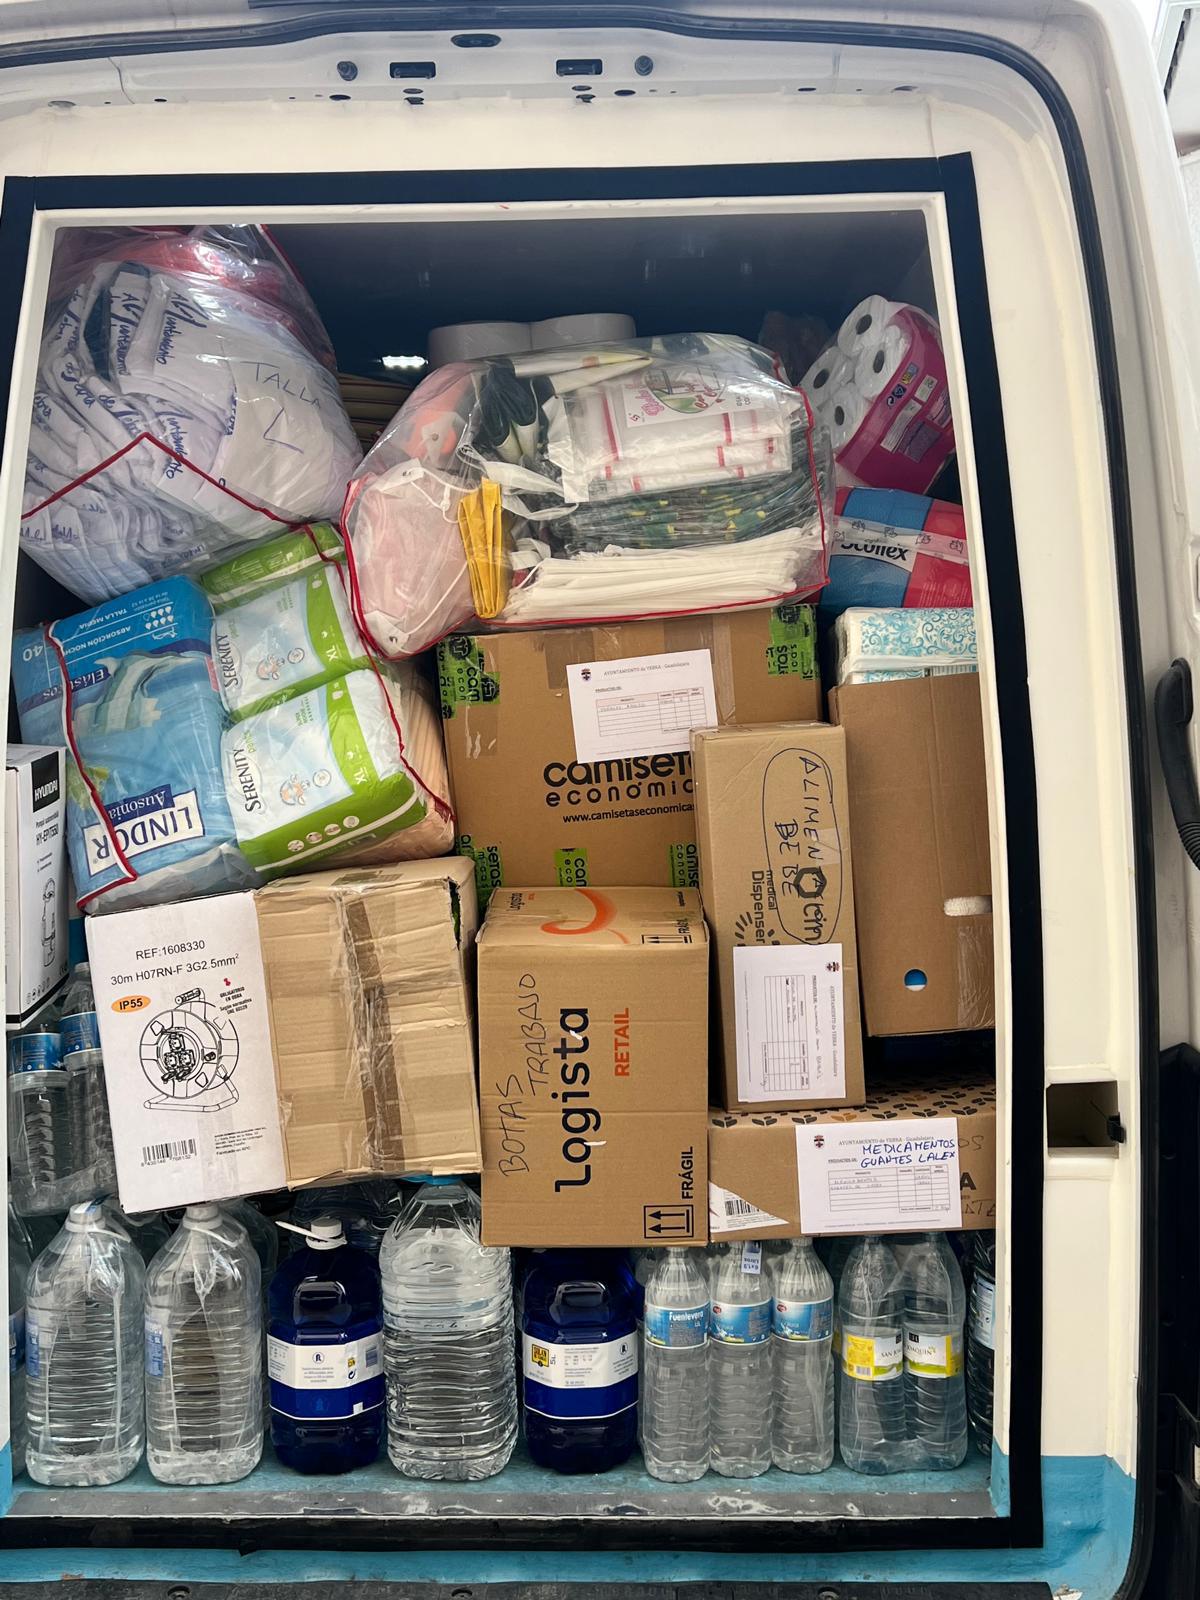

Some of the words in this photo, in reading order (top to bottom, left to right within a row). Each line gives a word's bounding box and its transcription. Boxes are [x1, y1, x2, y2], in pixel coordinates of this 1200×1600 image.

[240, 361, 321, 410] TALLA
[263, 407, 304, 454] L
[99, 608, 127, 625] TALLA
[22, 645, 45, 662] 40
[87, 625, 131, 649] ABSORCIÓN
[216, 632, 241, 688] SERENITY
[325, 645, 338, 663] XL
[42, 668, 105, 701] Elástos
[232, 747, 262, 813] SERENITY
[354, 766, 368, 786] XL
[543, 754, 693, 788] camiset
[34, 779, 58, 802] HYUNDAI
[108, 789, 168, 819] Ausonia
[766, 869, 777, 911] medical
[751, 870, 766, 944] Dispenser
[135, 940, 206, 960] REF:1608330
[111, 975, 133, 986] 30m
[136, 964, 183, 981] H07RN-F
[119, 998, 143, 1011] IP55
[517, 973, 551, 1096] TRABAJO
[614, 1007, 630, 1078] RETAIL
[551, 1007, 601, 1193] Logista
[496, 1073, 530, 1178] BOTAS
[860, 1154, 913, 1169] GUANTES
[862, 1139, 956, 1155] MEDICAMENTOS
[681, 1145, 694, 1201] FRÁGIL
